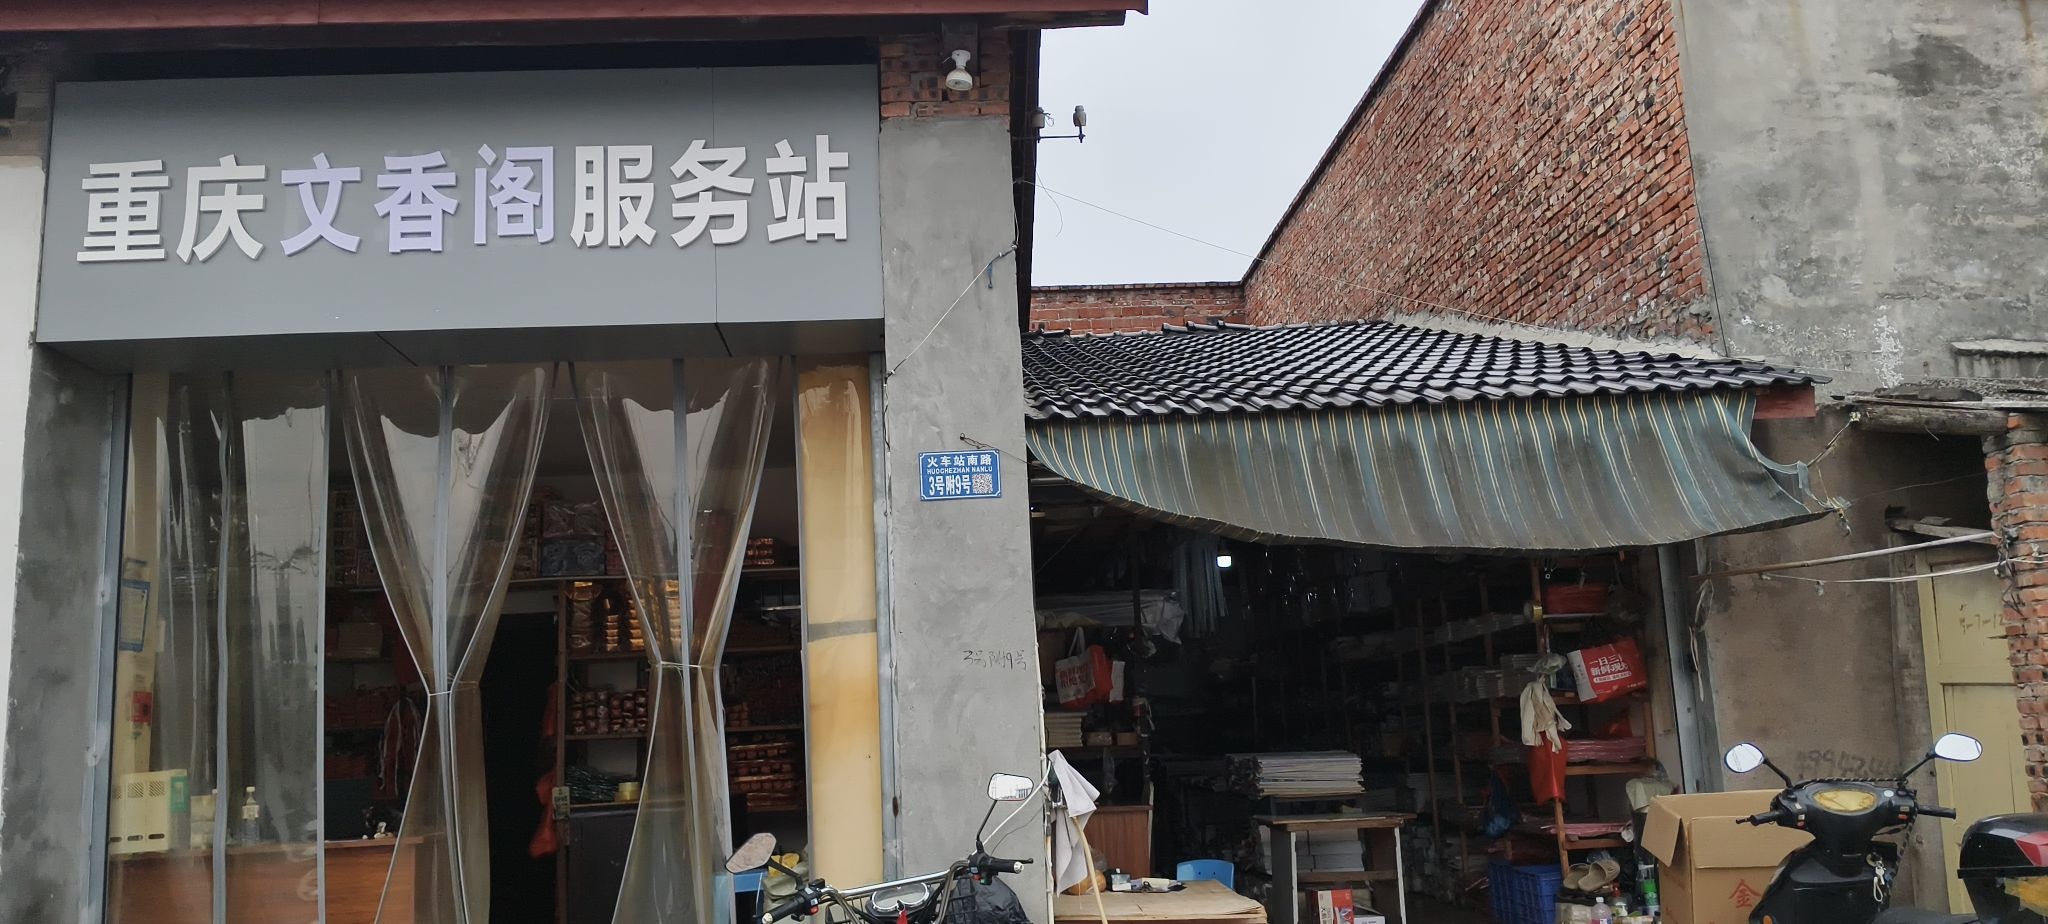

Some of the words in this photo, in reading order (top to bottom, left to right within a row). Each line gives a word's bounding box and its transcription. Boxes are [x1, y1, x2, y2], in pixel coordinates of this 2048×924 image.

[76, 134, 850, 263] 重庆文香阁服务站
[927, 454, 992, 468] 火车站南路
[927, 467, 970, 475] HUOCHEZHAN
[928, 474, 972, 496] 3号附9号
[1588, 653, 1624, 666] 一日三
[1727, 878, 1762, 909] 金
